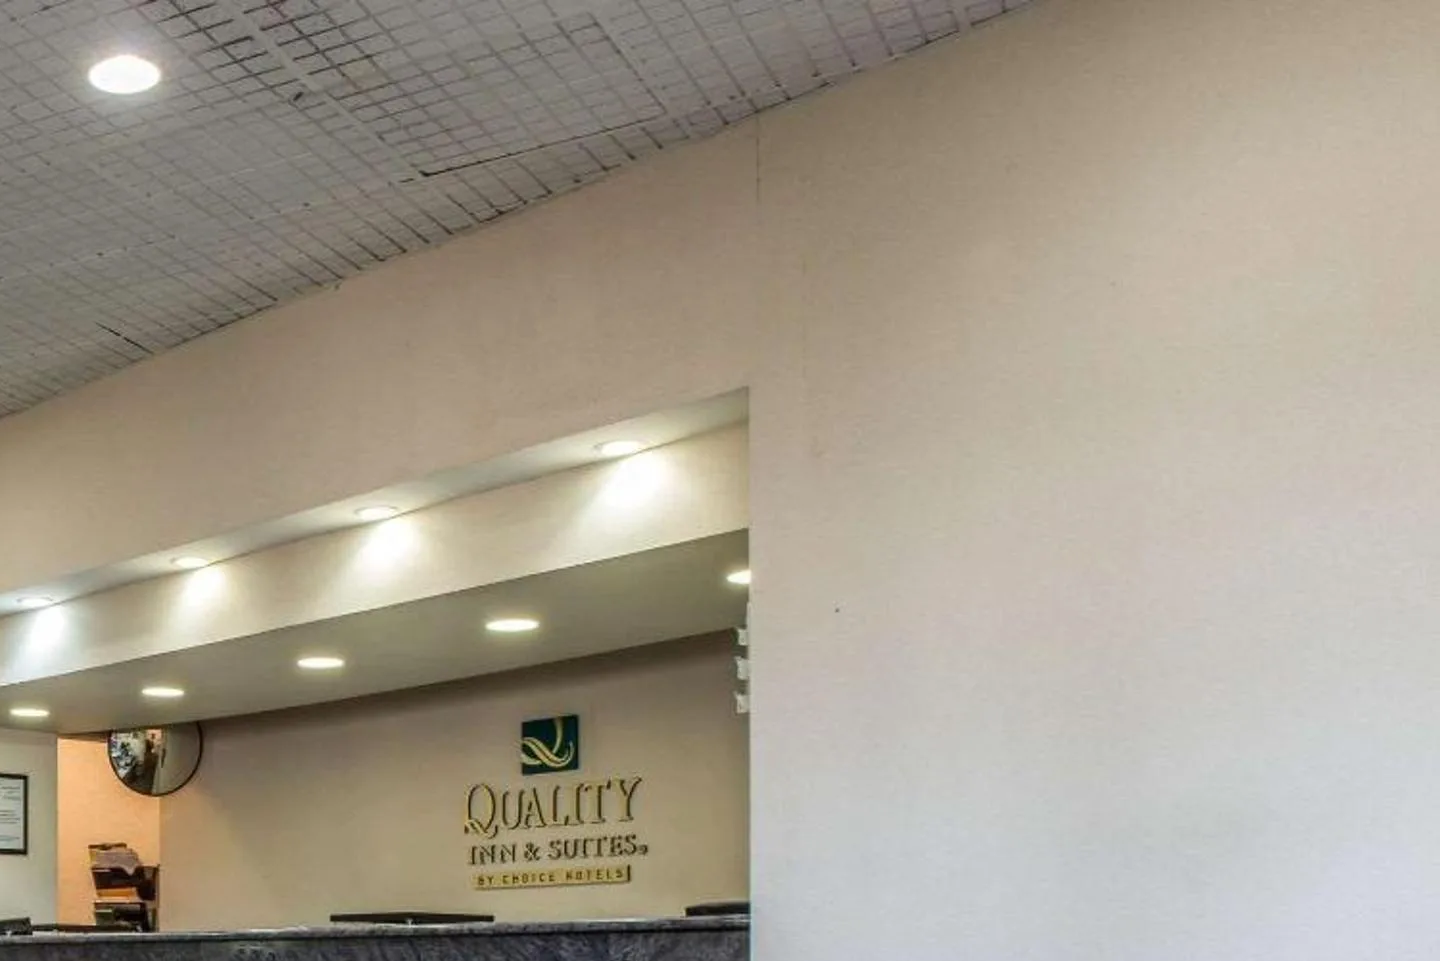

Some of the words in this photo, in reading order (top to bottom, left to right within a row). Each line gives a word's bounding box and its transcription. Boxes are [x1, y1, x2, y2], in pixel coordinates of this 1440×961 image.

[465, 777, 642, 839] QUALITY
[468, 843, 516, 865] INN
[524, 842, 540, 861] &
[549, 834, 637, 860] SUITES
[477, 875, 493, 886] BY
[503, 872, 555, 884] CHOICE
[566, 869, 623, 881] HOTELS
